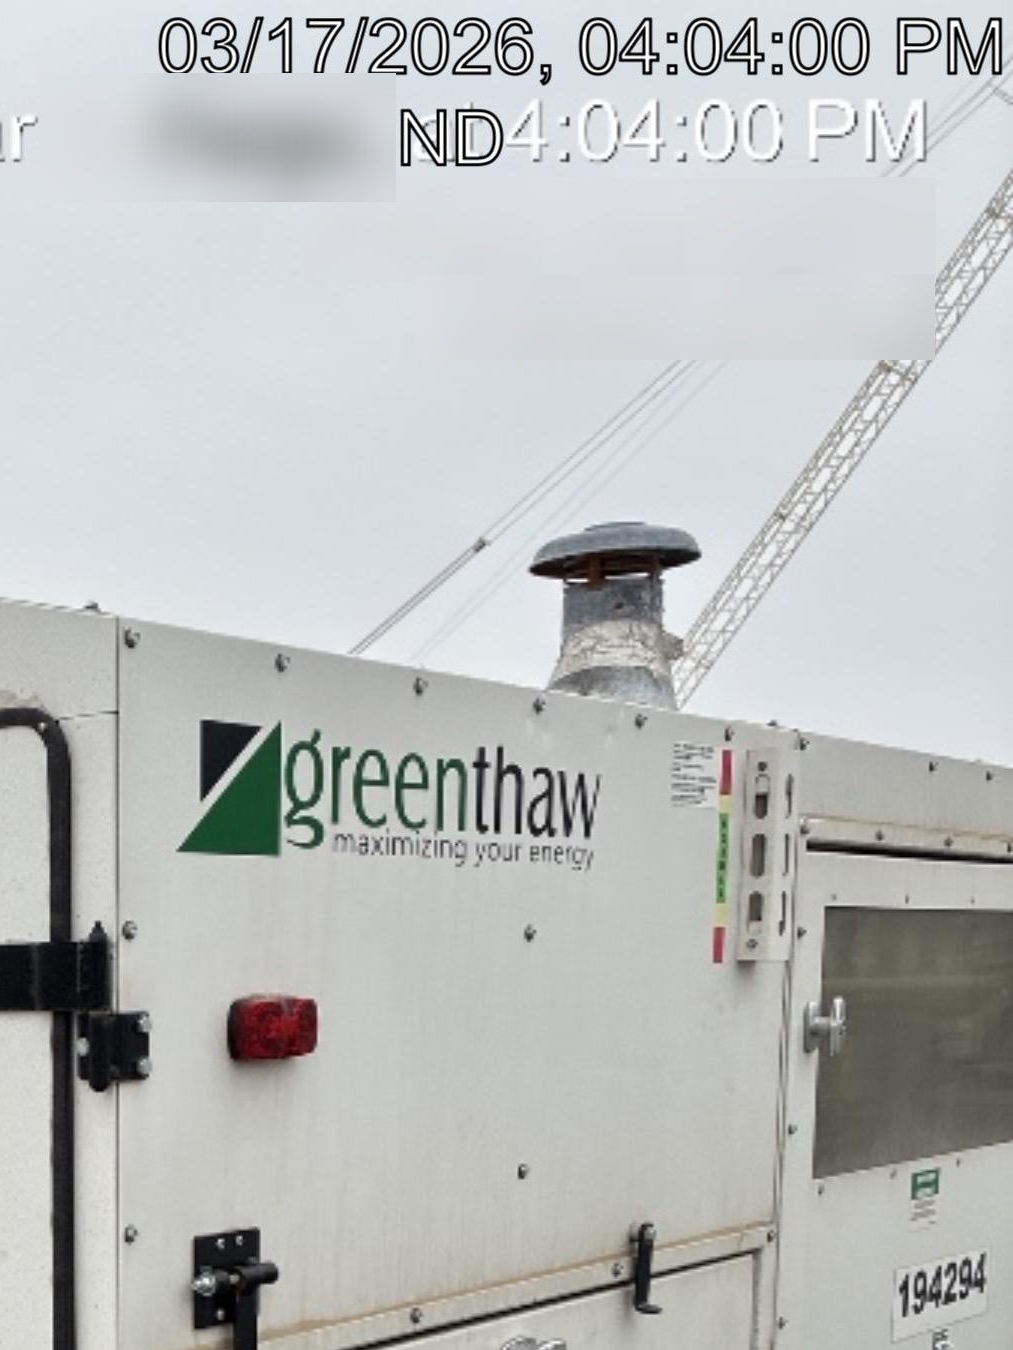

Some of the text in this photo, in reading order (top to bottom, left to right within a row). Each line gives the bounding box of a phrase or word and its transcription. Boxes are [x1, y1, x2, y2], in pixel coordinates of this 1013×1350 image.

[284, 728, 602, 850] greenthaw
[332, 829, 595, 871] maximizing your energy
[898, 1251, 987, 1318] 194294
